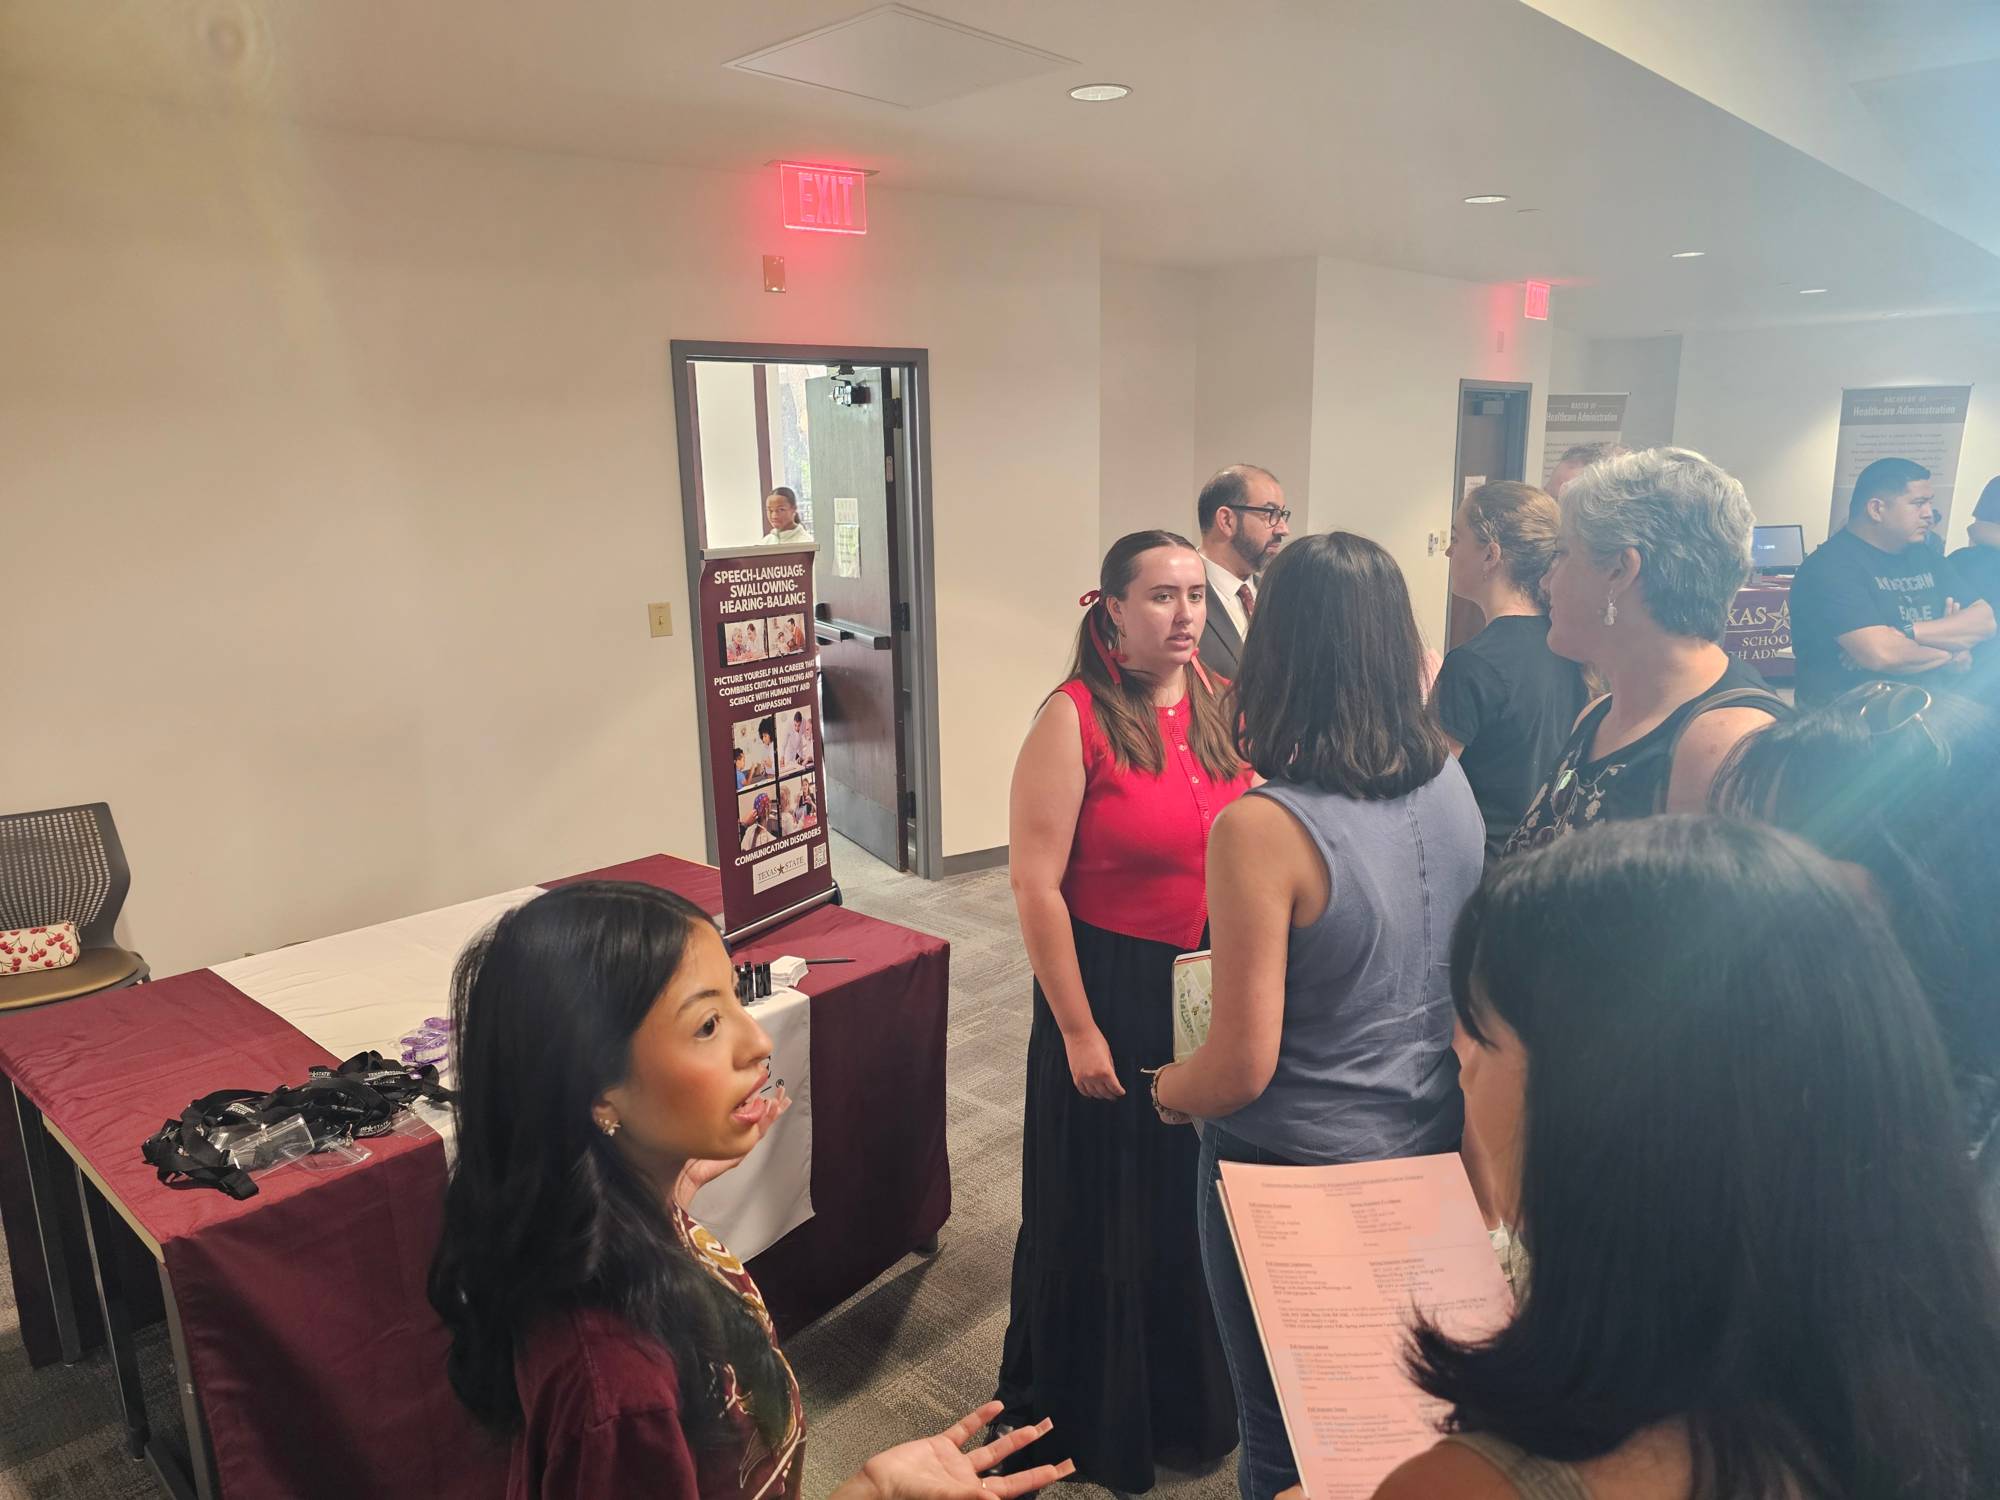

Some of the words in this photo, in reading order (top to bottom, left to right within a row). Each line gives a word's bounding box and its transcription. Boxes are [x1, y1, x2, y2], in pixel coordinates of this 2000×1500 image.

[798, 172, 853, 226] EXIT
[1853, 407, 1896, 416] Healthcare
[1896, 404, 1956, 416] Administration
[714, 564, 806, 584] SPEECH-LANGUAGE-
[730, 579, 798, 598] SWALLOWING-
[719, 592, 806, 614] HEARING-BALANCE
[1742, 634, 1792, 647] SCHOO
[714, 674, 743, 686] PICTURE
[743, 667, 771, 682] YOURSELF
[772, 667, 778, 675] IN
[779, 666, 785, 674] A
[784, 662, 805, 674] CAREER
[805, 659, 815, 669] THAT
[719, 683, 754, 697] COMBINES
[754, 679, 778, 690] CRITICAL
[779, 673, 804, 685] THINKING
[804, 670, 814, 680] AND
[729, 694, 755, 707] SCIENCE
[755, 690, 770, 701] WITH
[770, 684, 799, 698] HUMANITY
[799, 682, 810, 692] AND
[754, 697, 792, 712] COMPASSION
[734, 838, 789, 867] COMMUNICATION
[789, 826, 822, 846] DISORDERS
[757, 866, 778, 881] TEXAS
[785, 856, 804, 869] STATE
